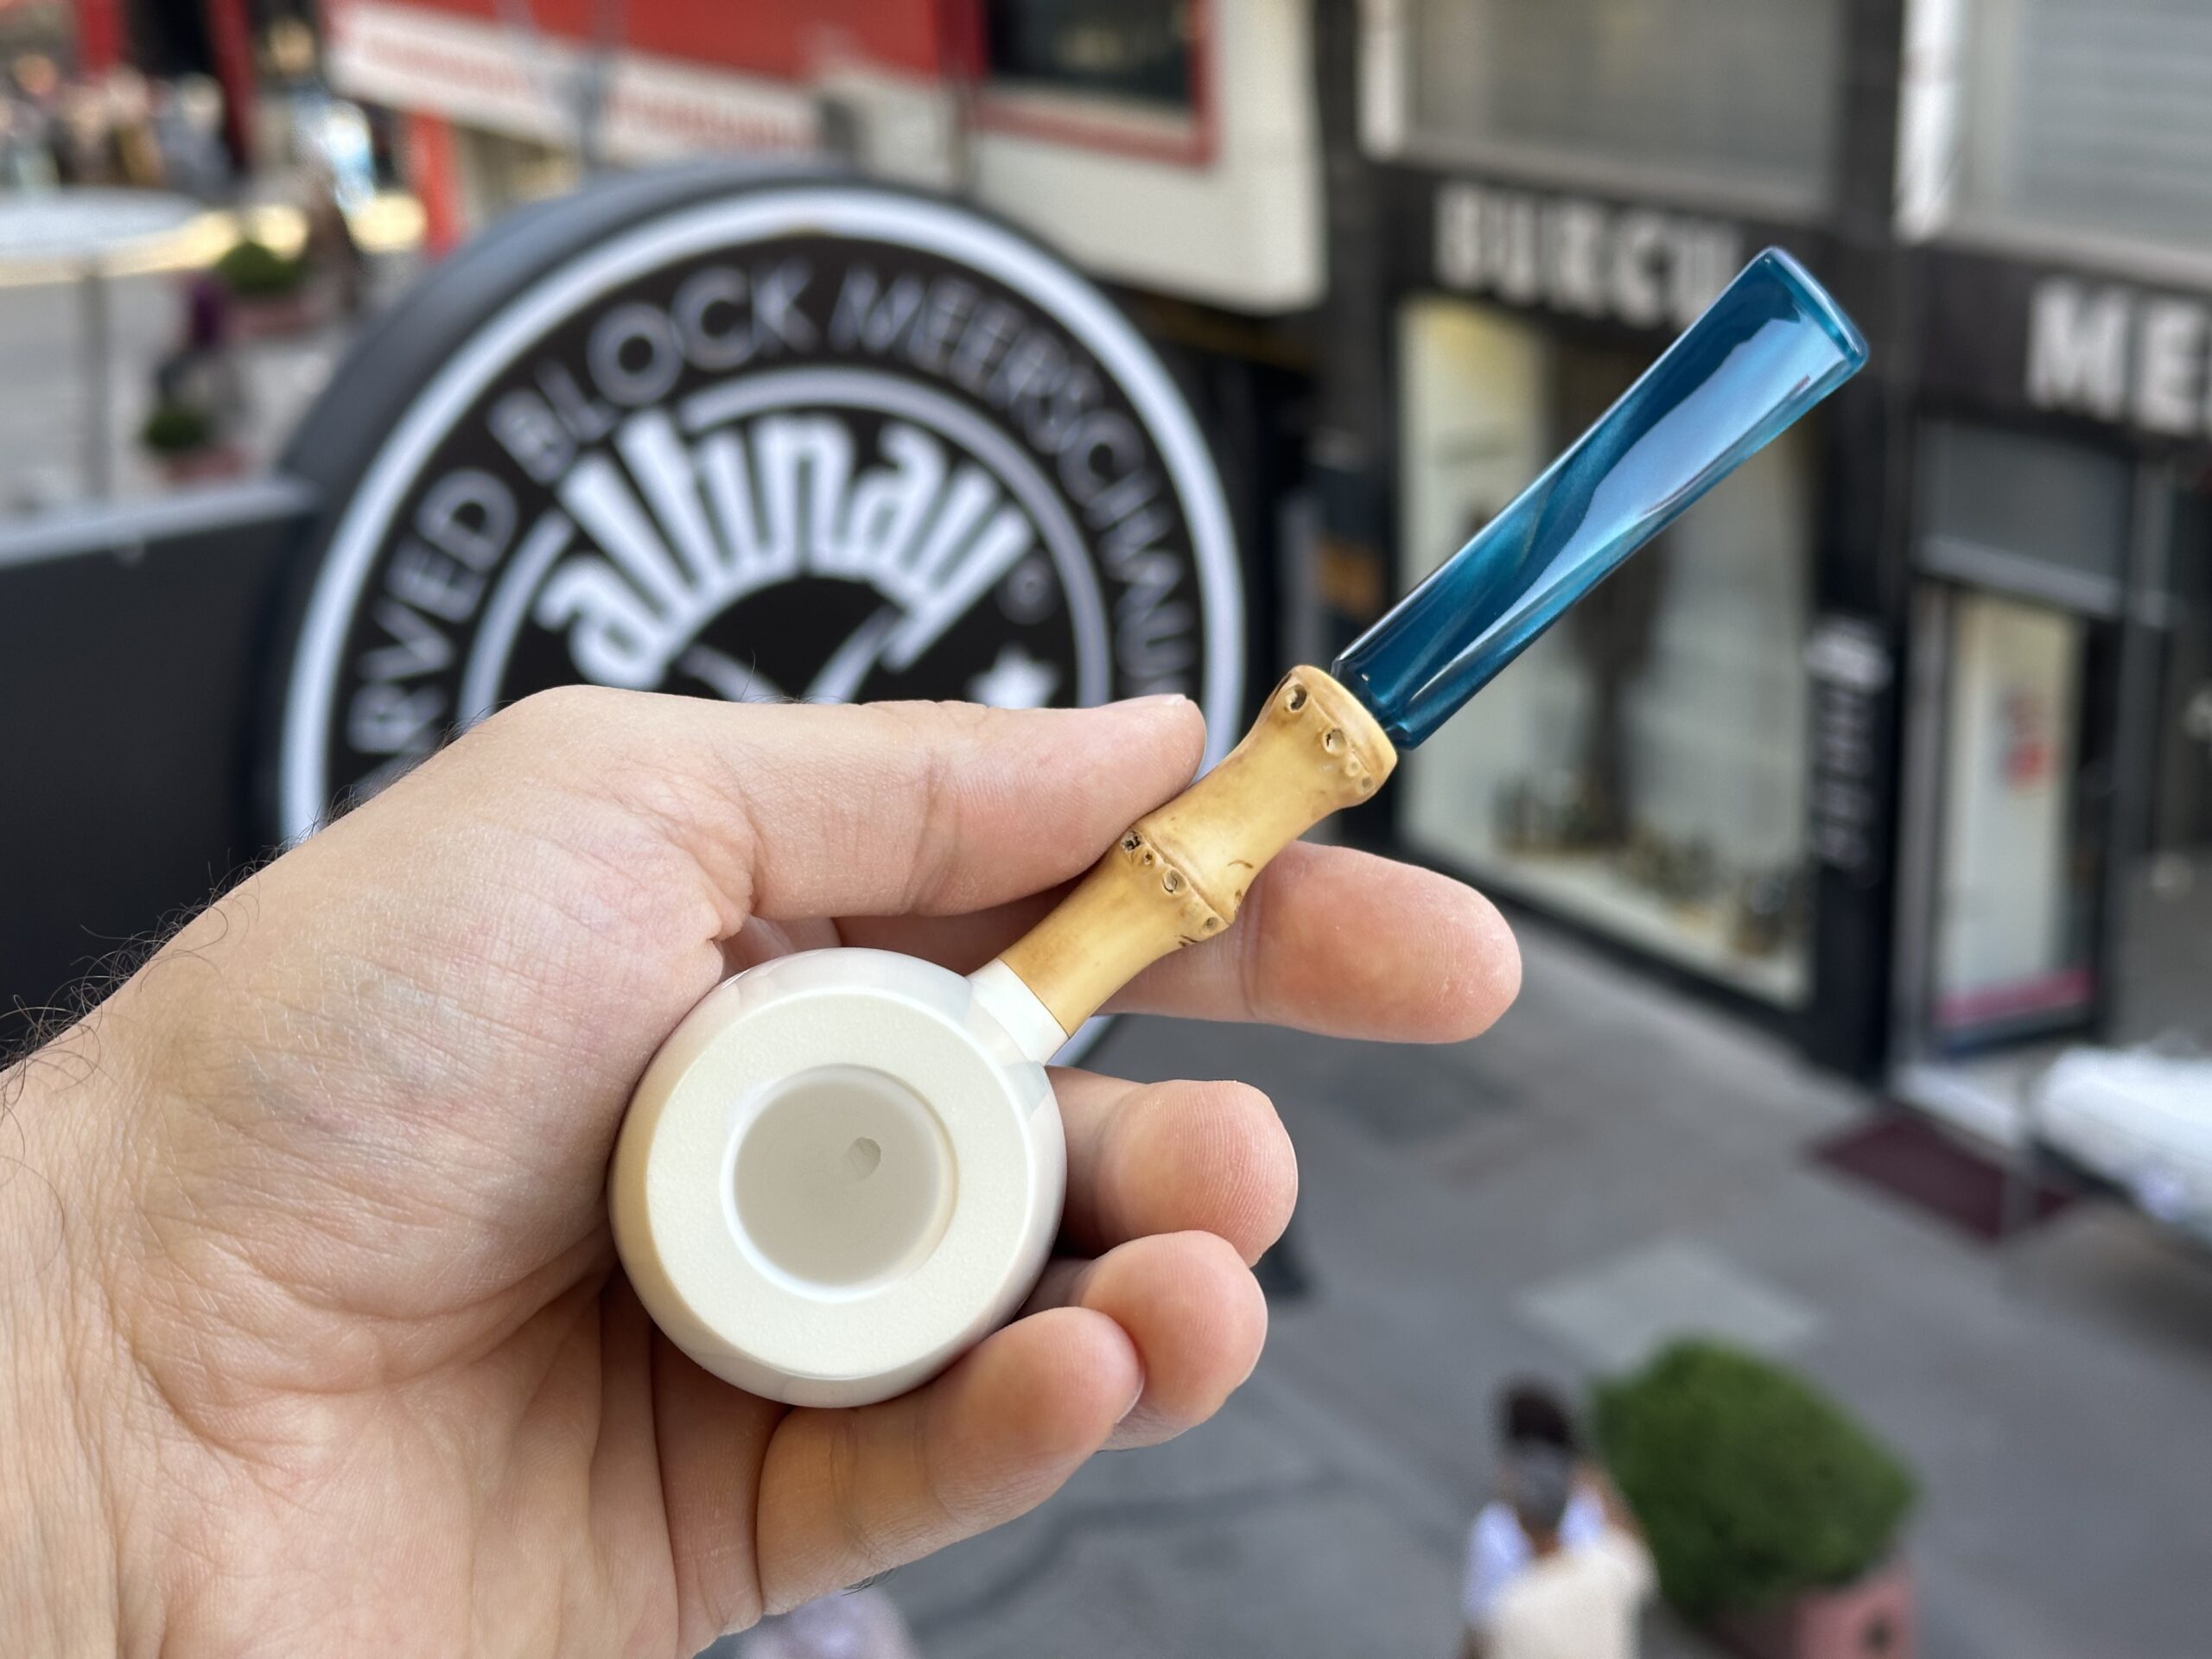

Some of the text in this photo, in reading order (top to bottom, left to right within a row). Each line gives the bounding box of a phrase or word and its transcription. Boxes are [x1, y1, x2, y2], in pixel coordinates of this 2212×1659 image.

[489, 257, 820, 486] BLOCK
[828, 264, 1196, 698] MEERSCHAU
[2026, 277, 2212, 437] ME
